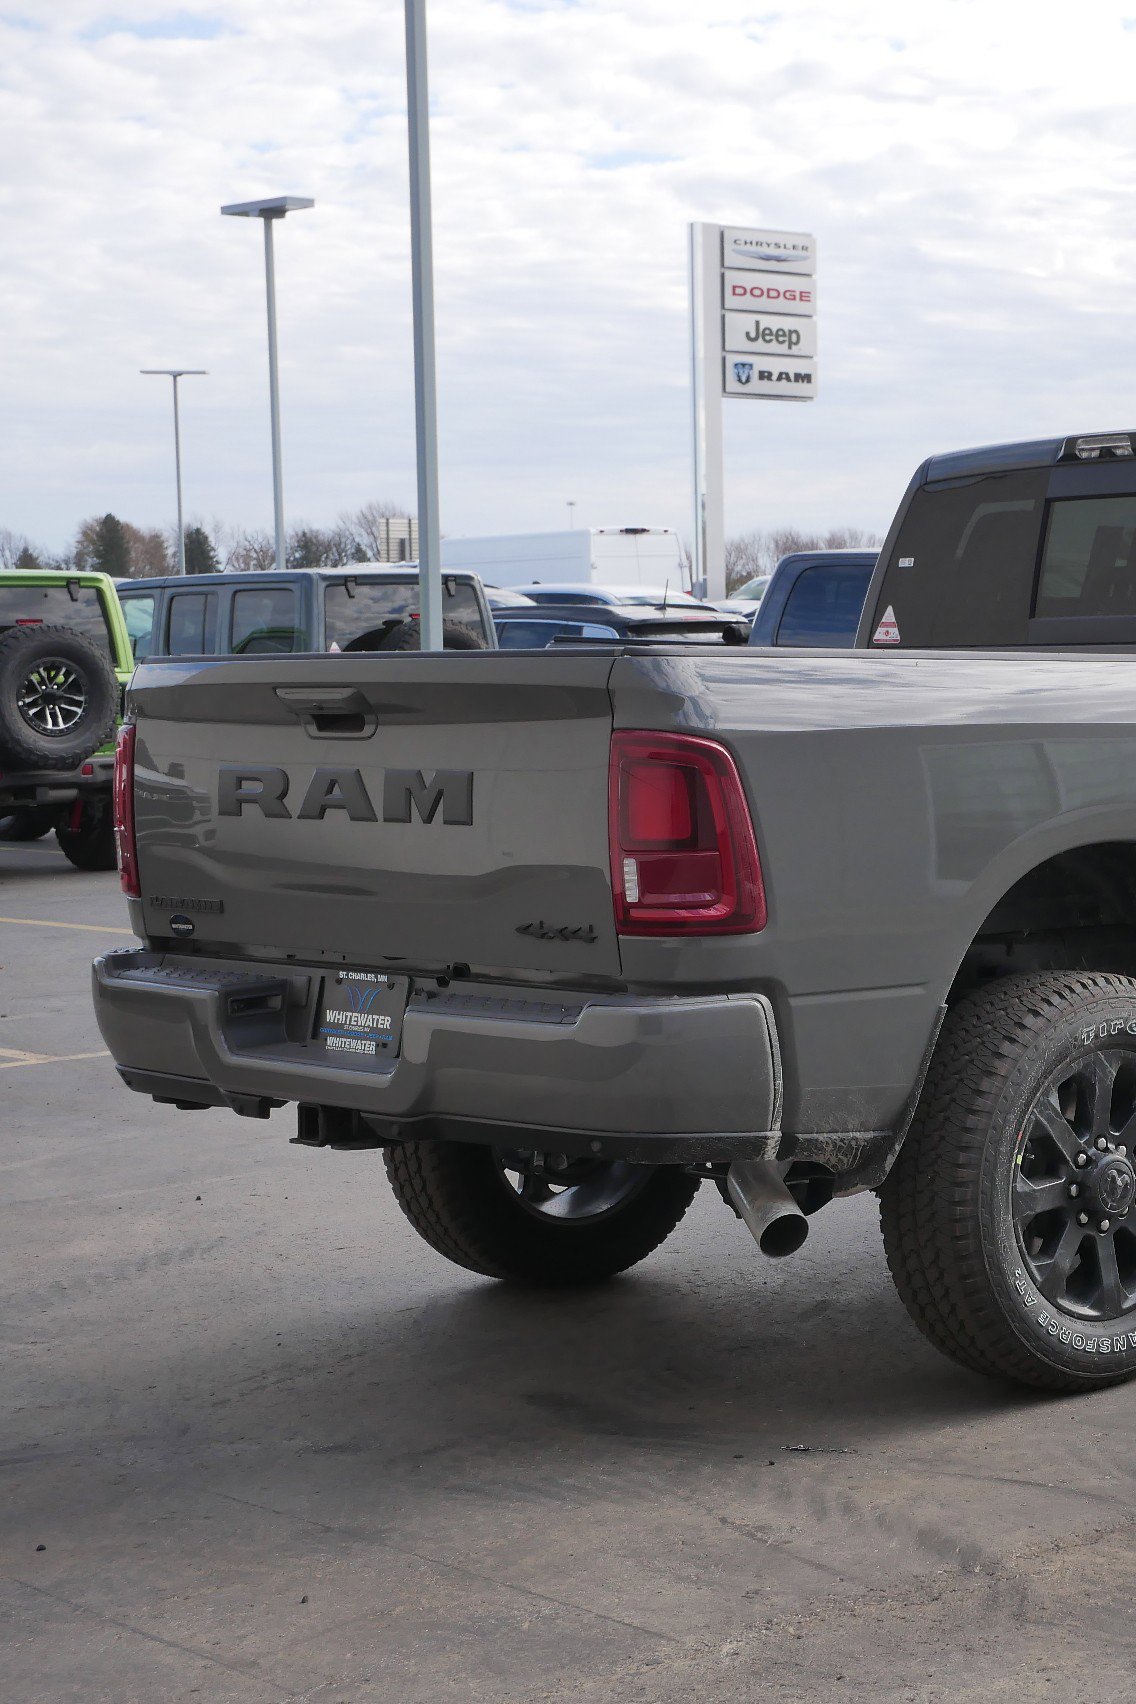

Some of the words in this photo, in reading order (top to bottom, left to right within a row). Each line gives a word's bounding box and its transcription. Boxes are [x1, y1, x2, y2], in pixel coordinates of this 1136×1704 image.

[733, 238, 809, 252] CHRYSLER
[731, 285, 811, 302] DODGE
[745, 320, 801, 350] Jeep
[758, 370, 812, 384] RAM
[218, 765, 474, 826] RAM
[514, 920, 599, 943] 4x4
[339, 970, 348, 980] ST.
[348, 971, 377, 983] CHARLES,
[377, 974, 389, 983] MN
[326, 1009, 392, 1030] WHITEWATER
[326, 1036, 376, 1052] WHITEWATER
